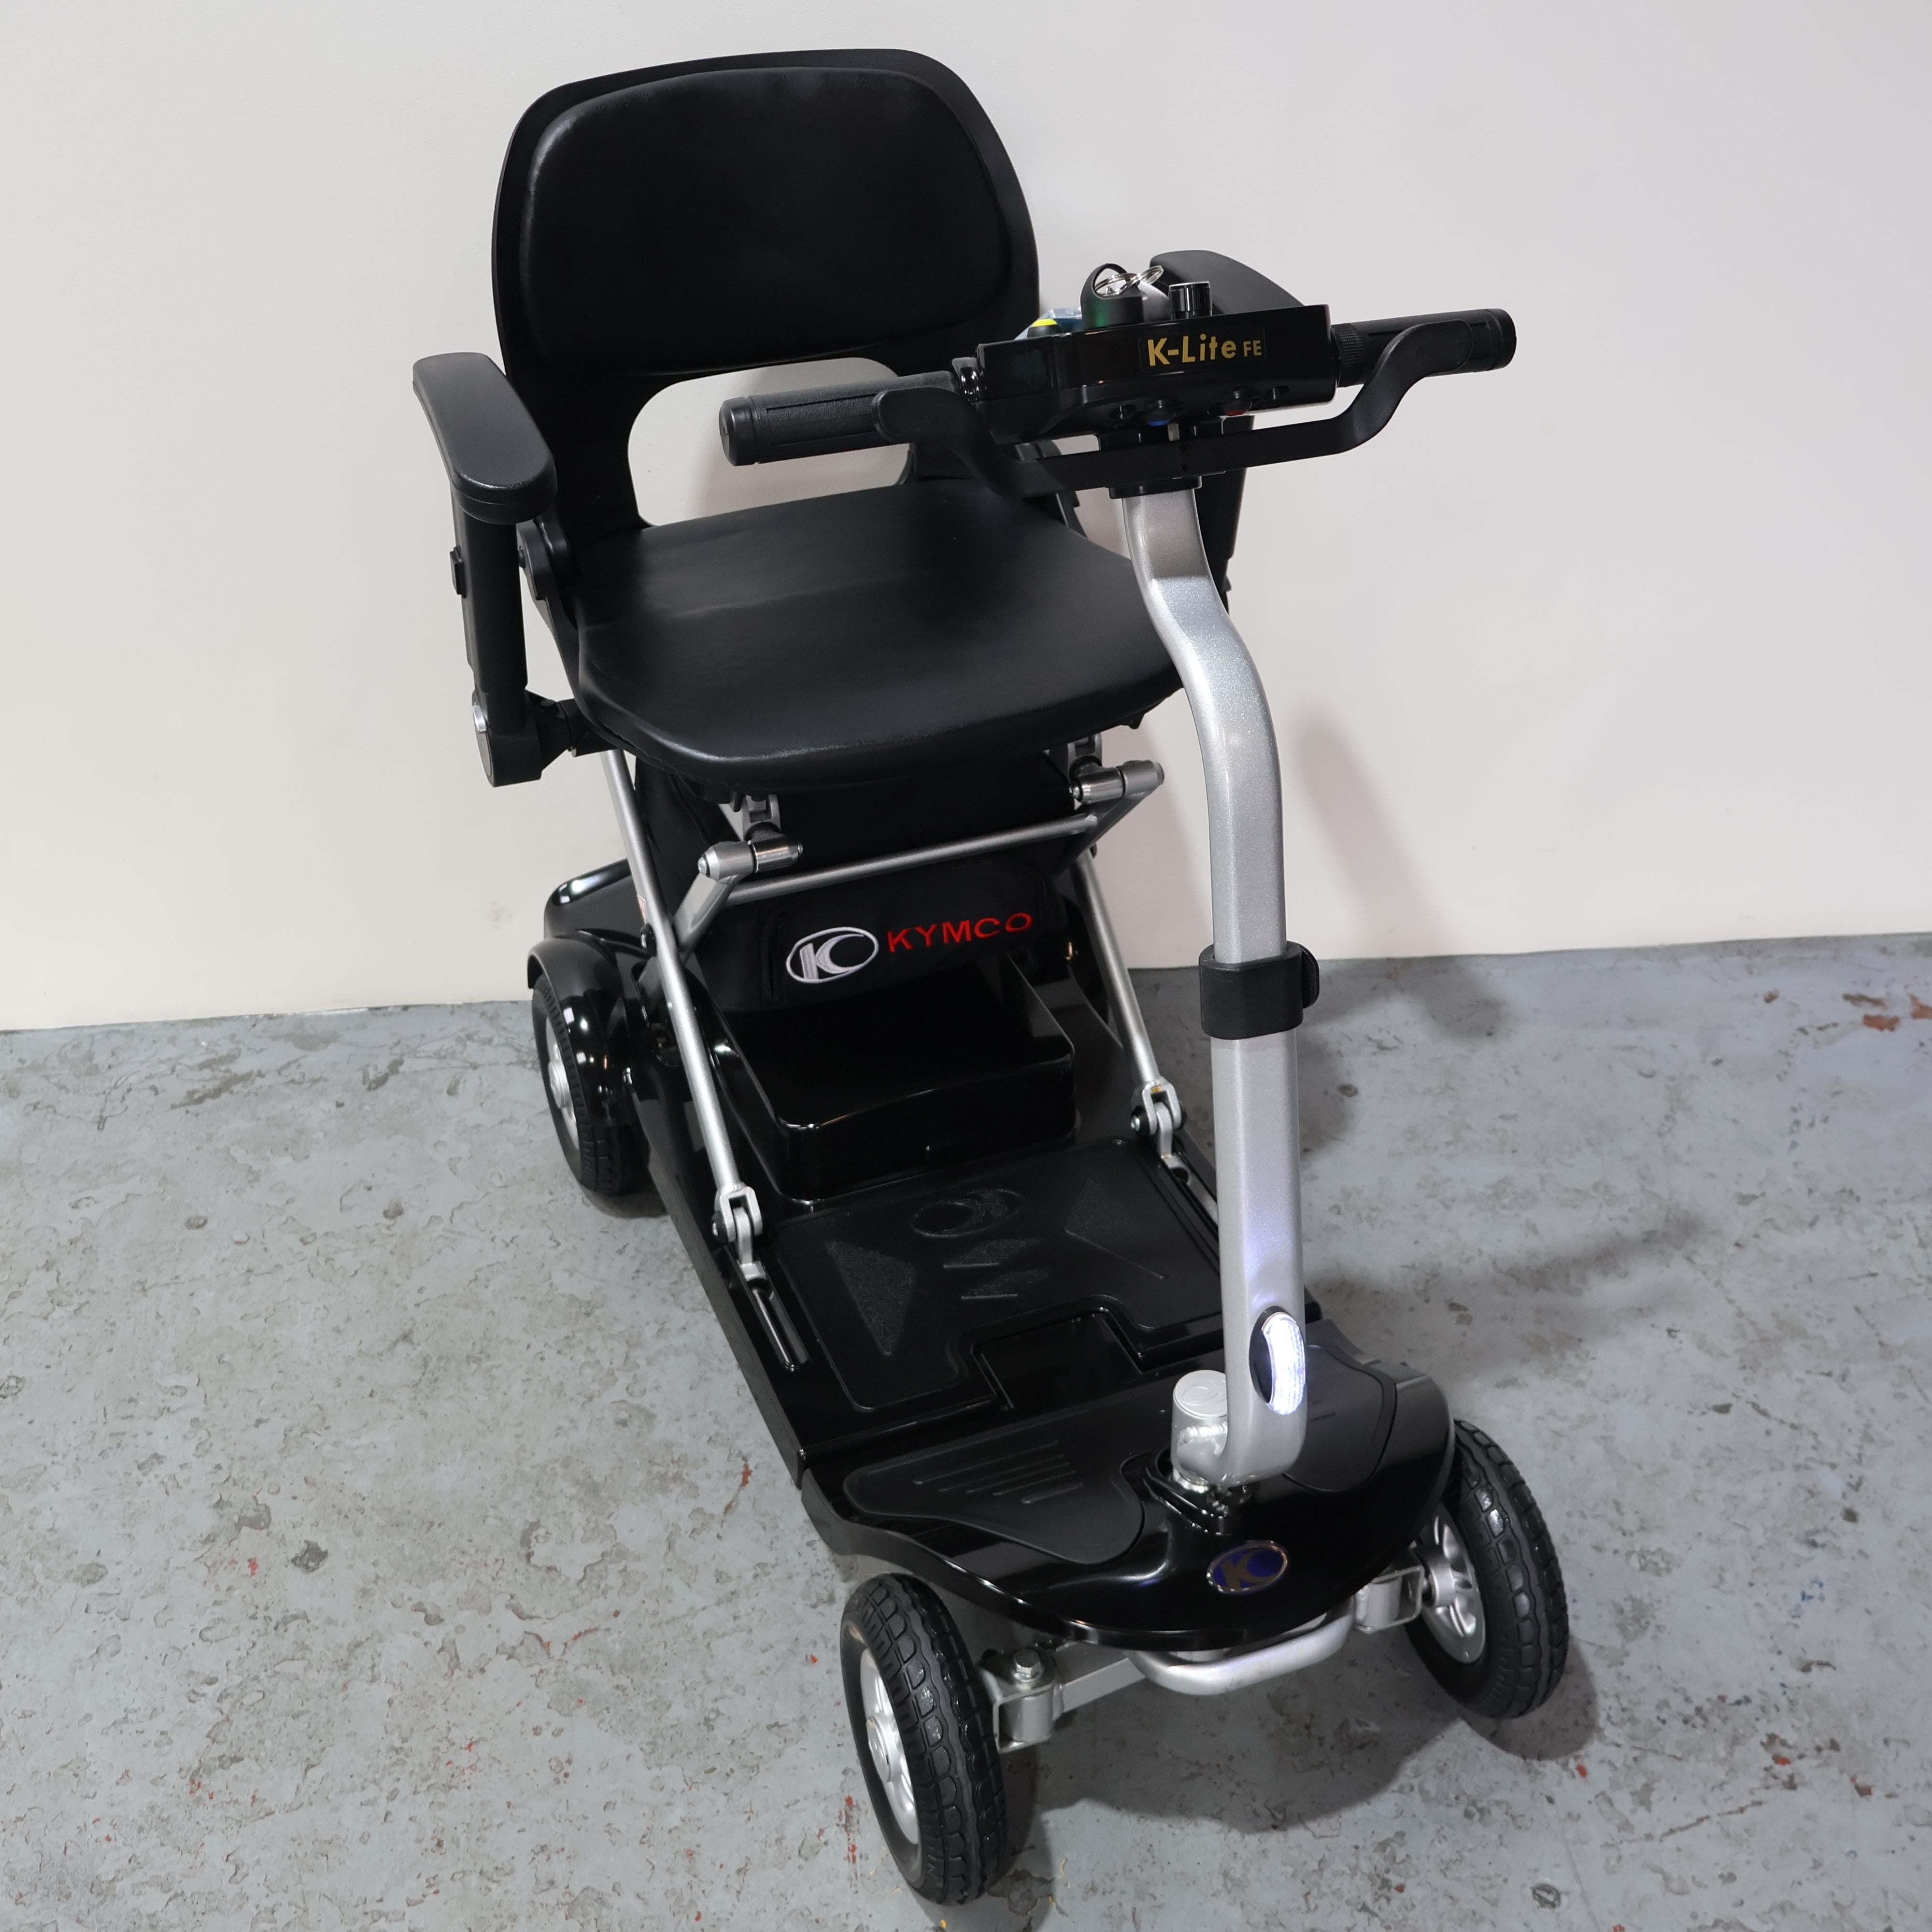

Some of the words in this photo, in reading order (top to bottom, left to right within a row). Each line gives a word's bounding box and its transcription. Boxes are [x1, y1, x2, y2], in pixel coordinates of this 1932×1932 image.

[1148, 333, 1236, 366] K-Lite
[1243, 340, 1262, 357] FE
[887, 912, 1033, 953] KYMCO
